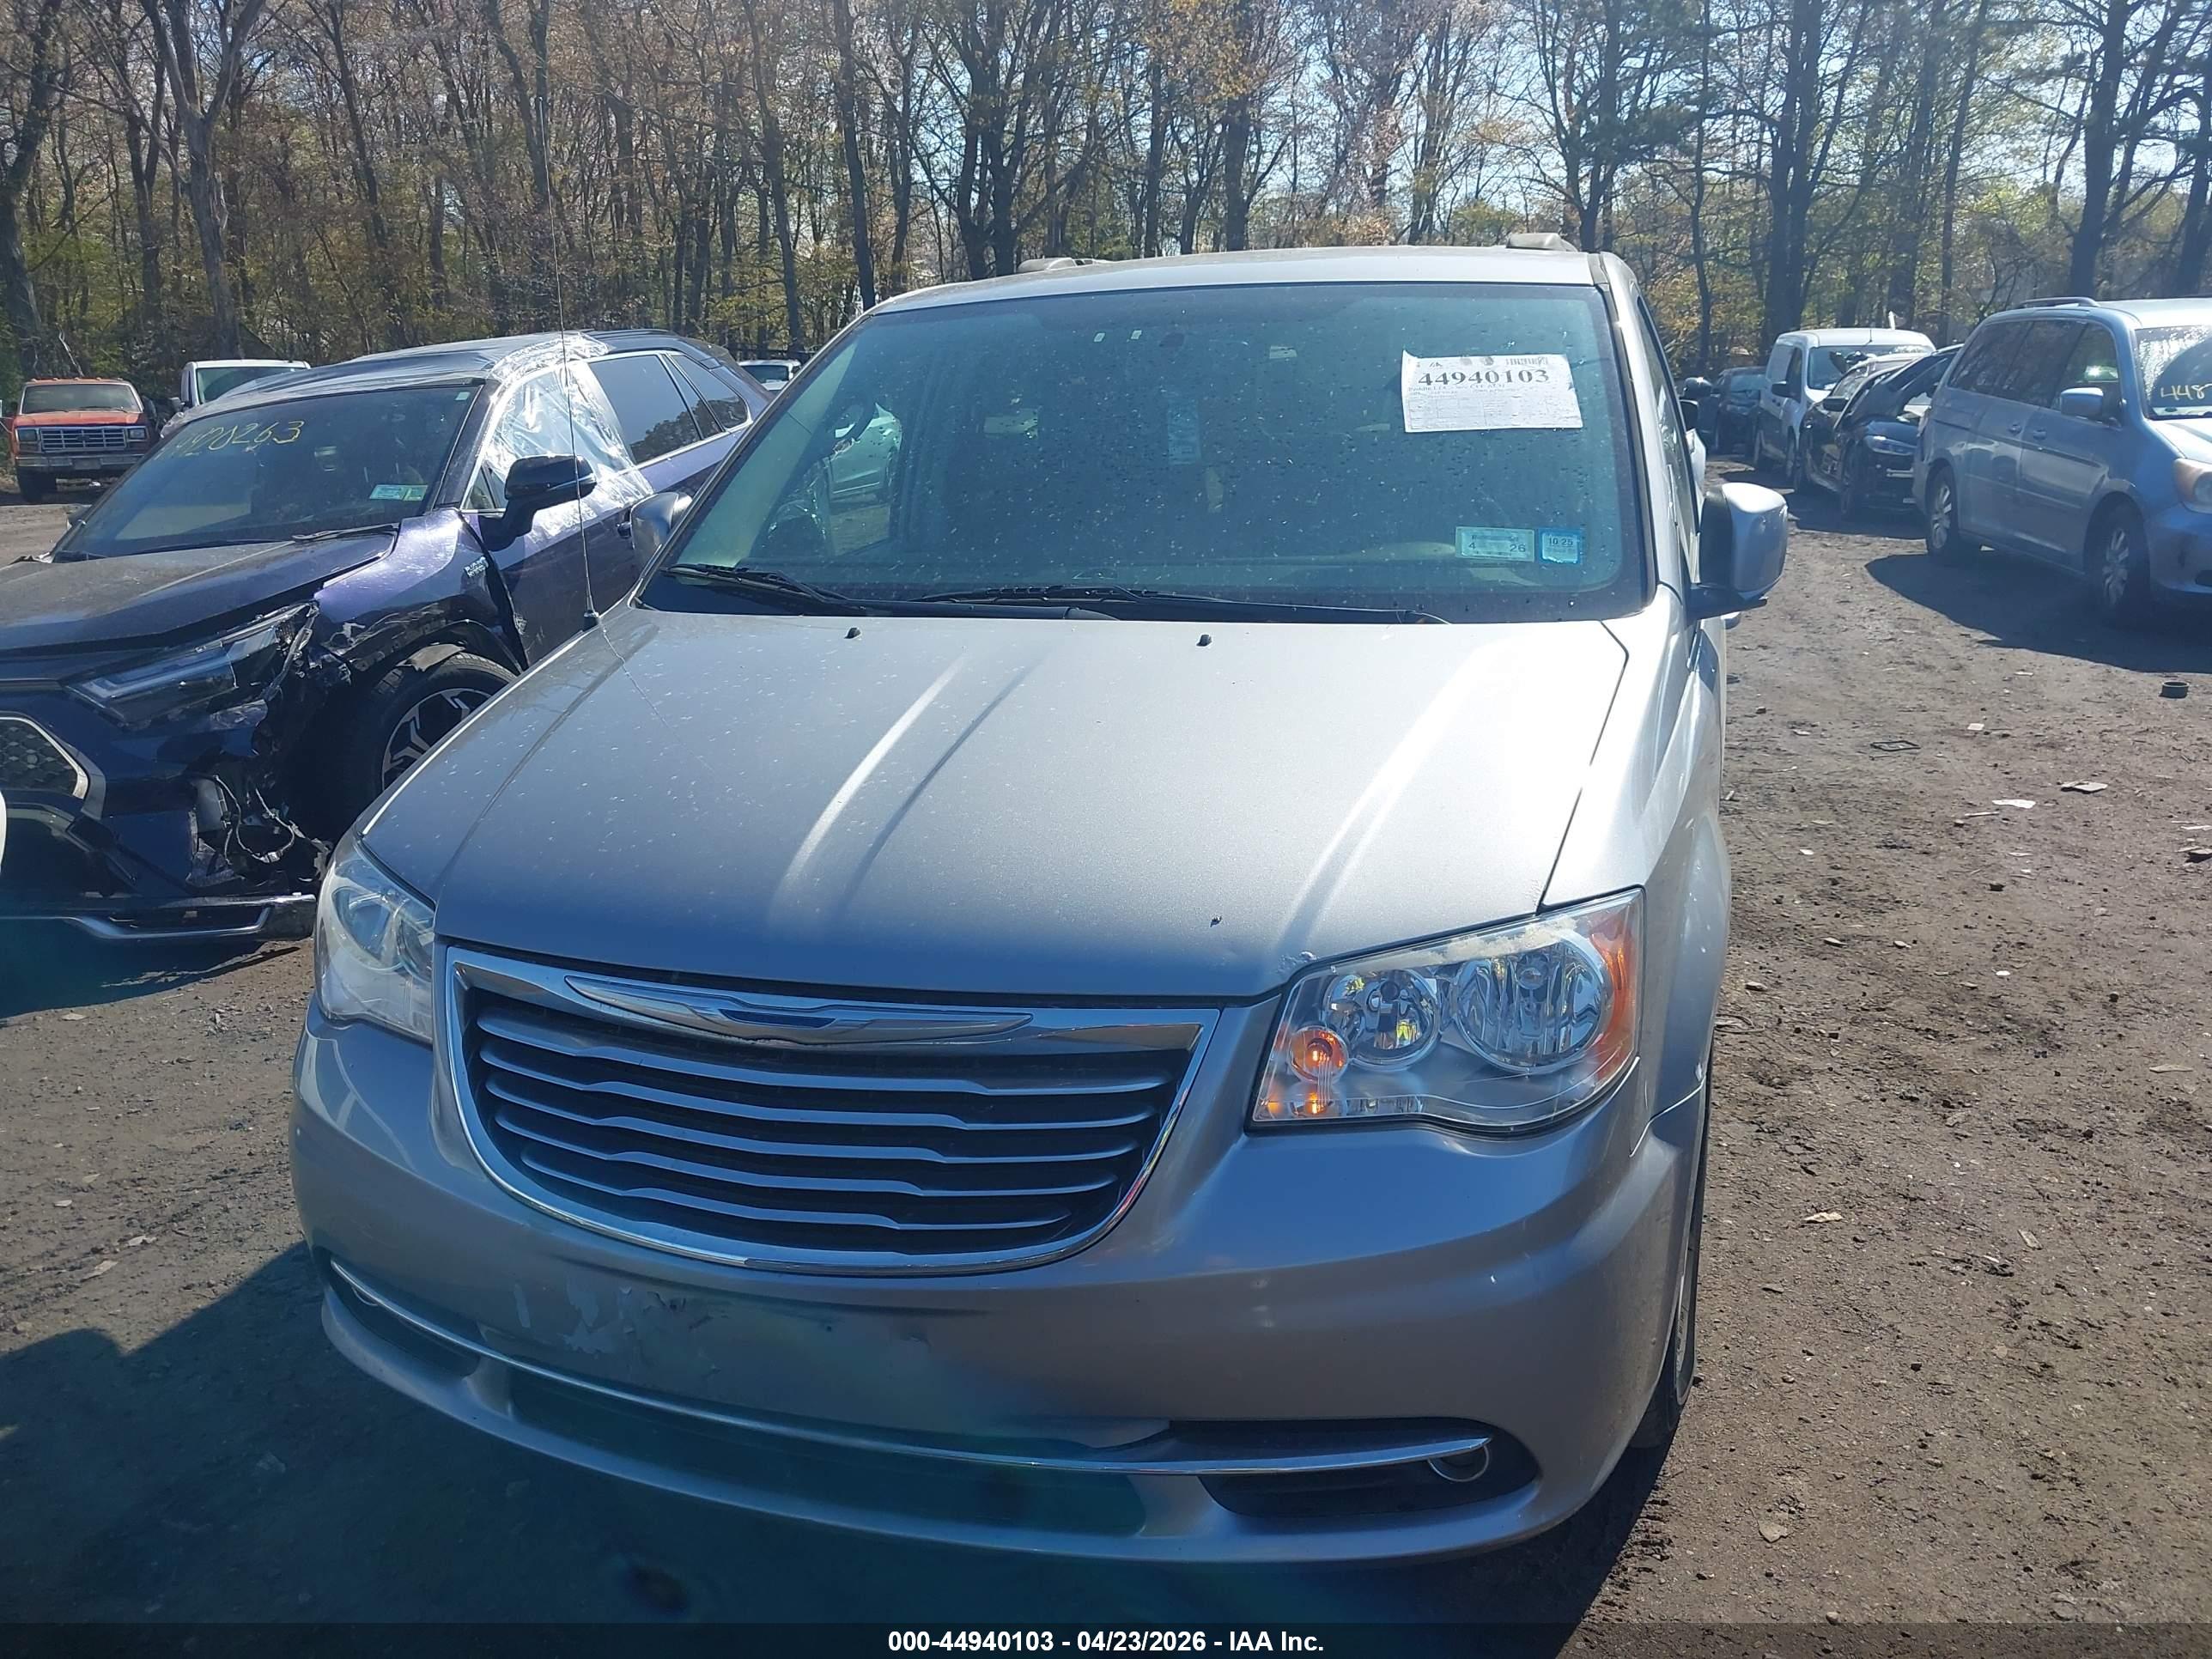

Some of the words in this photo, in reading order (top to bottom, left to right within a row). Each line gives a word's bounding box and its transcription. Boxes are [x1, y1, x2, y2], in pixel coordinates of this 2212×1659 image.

[1418, 368, 1550, 386] 44940103
[1561, 538, 1574, 547] 25
[1510, 544, 1527, 553] 26
